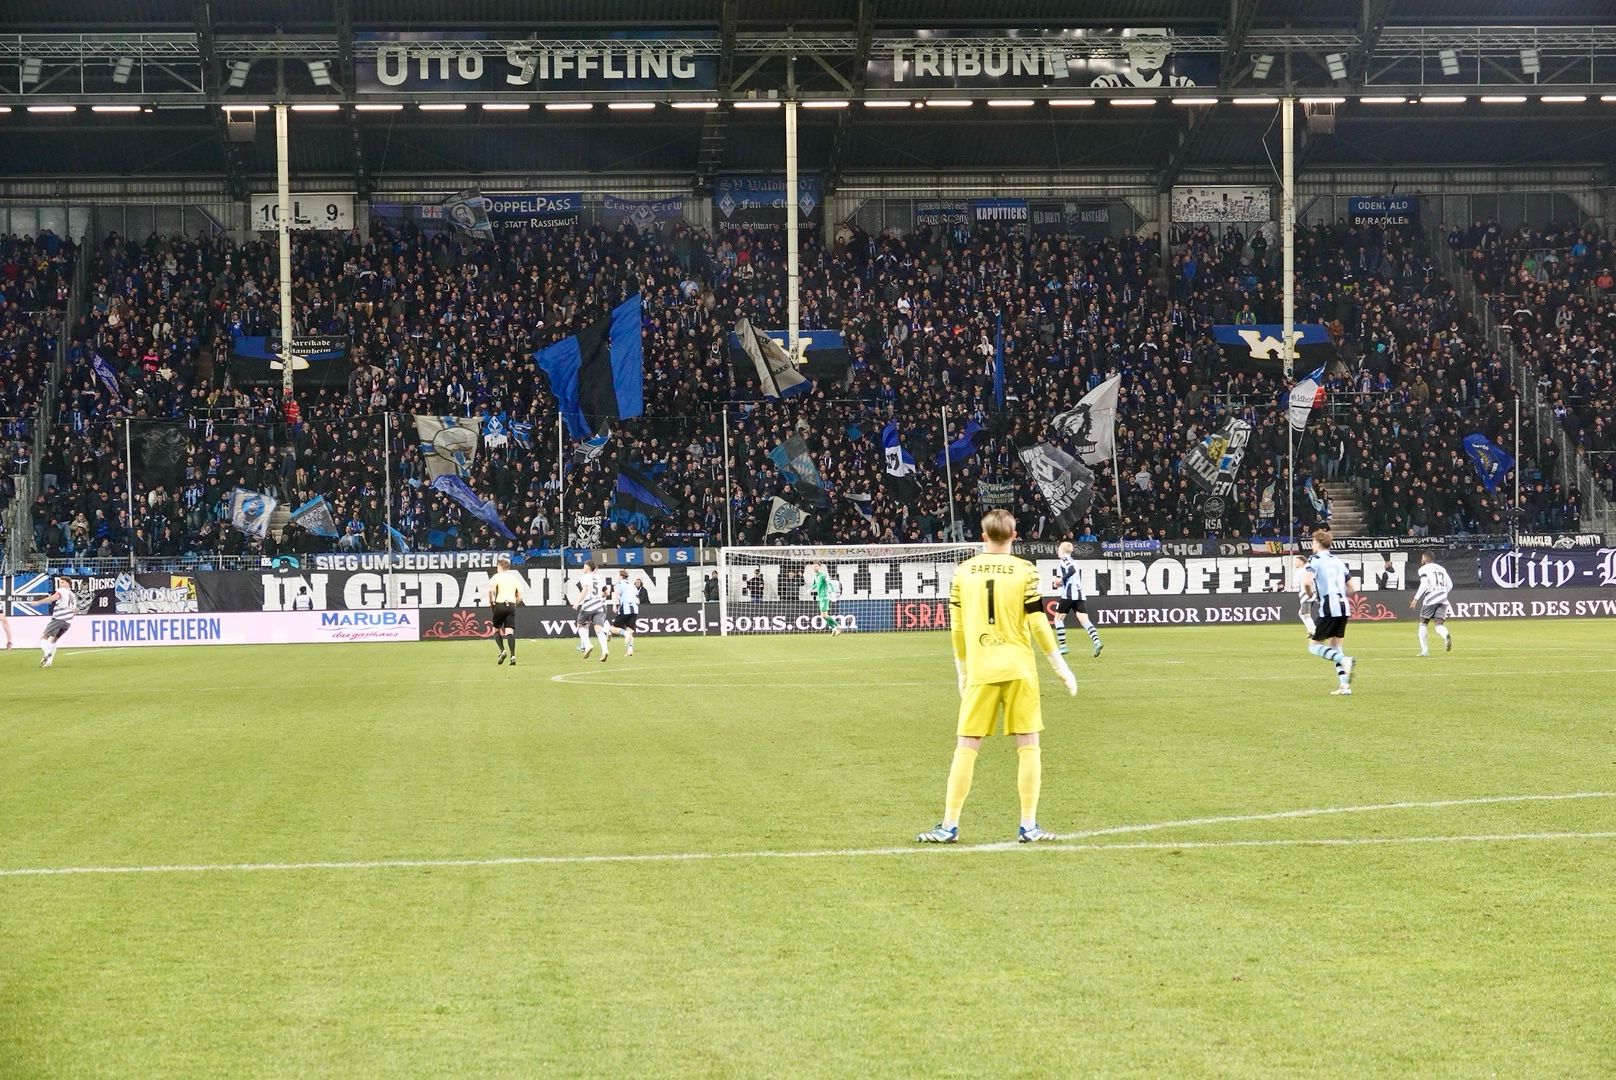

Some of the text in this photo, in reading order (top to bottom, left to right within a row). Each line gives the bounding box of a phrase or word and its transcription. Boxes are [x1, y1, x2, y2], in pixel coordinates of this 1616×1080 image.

[748, 179, 787, 191] Waldh
[773, 199, 787, 208] Cl
[294, 202, 311, 224] L
[326, 204, 338, 222] 9
[976, 206, 1027, 220] KAPUTTICKS
[742, 221, 773, 230] Schwar
[1355, 216, 1405, 225] BARACKLE
[1050, 480, 1086, 516] OWER
[1205, 519, 1222, 530] KSA
[1300, 539, 1345, 551] KOTIV
[1348, 538, 1373, 549] SECHS
[1518, 535, 1552, 547] BARACKLER
[574, 549, 711, 562] TIFOSI
[1012, 542, 1060, 556] OF-POW
[316, 553, 511, 570] SIEG UM JEDEN PREIS
[971, 565, 1015, 574] BARTELS
[1491, 550, 1575, 588] City
[54, 577, 116, 591] DTY DICKS
[1433, 571, 1445, 587] 13
[262, 573, 328, 611] IN
[592, 582, 599, 596] 5
[99, 597, 109, 608] 18
[986, 579, 995, 625] 1
[1445, 601, 1526, 618] ARTNER
[1531, 600, 1570, 616] DES
[896, 603, 946, 629] ISRA
[1097, 606, 1282, 624] INTERIOR DESIGN
[91, 618, 221, 641] FIRMENFEIERN
[541, 610, 858, 636] wwsrael-sons.com
